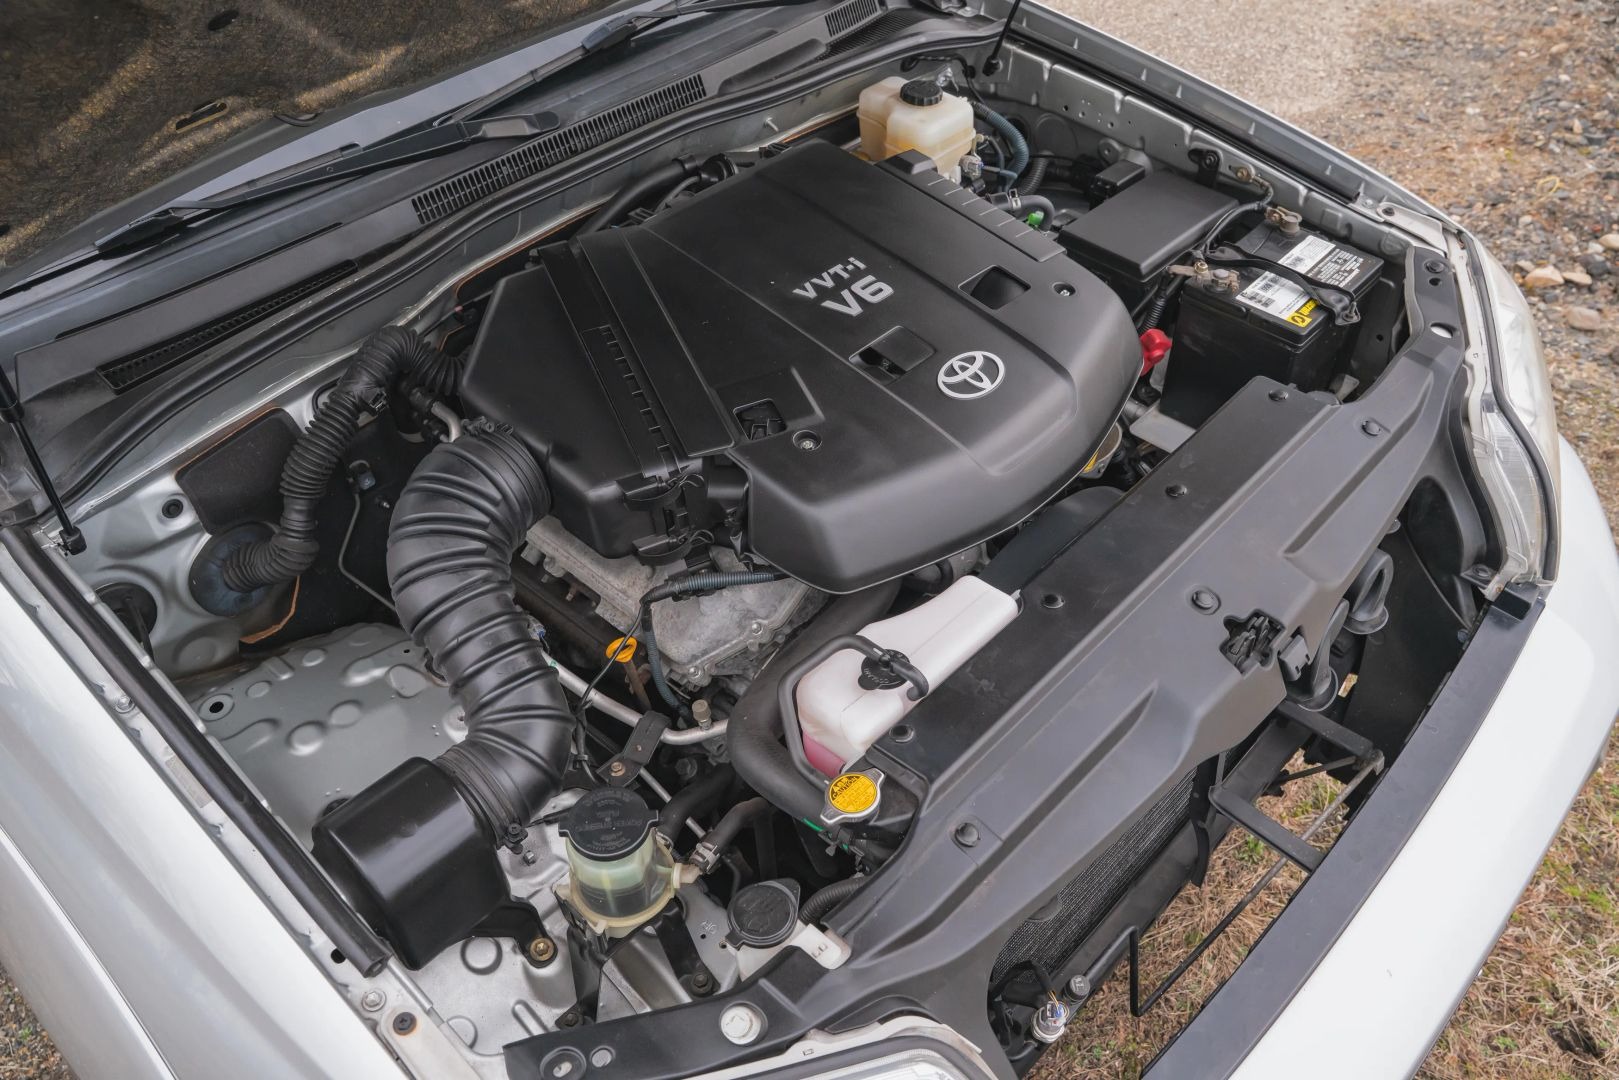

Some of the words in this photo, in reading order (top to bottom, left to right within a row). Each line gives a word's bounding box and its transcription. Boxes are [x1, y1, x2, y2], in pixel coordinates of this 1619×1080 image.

[792, 256, 867, 300] VVT-i
[821, 274, 894, 317] V6
[833, 776, 857, 799] CAUTION
